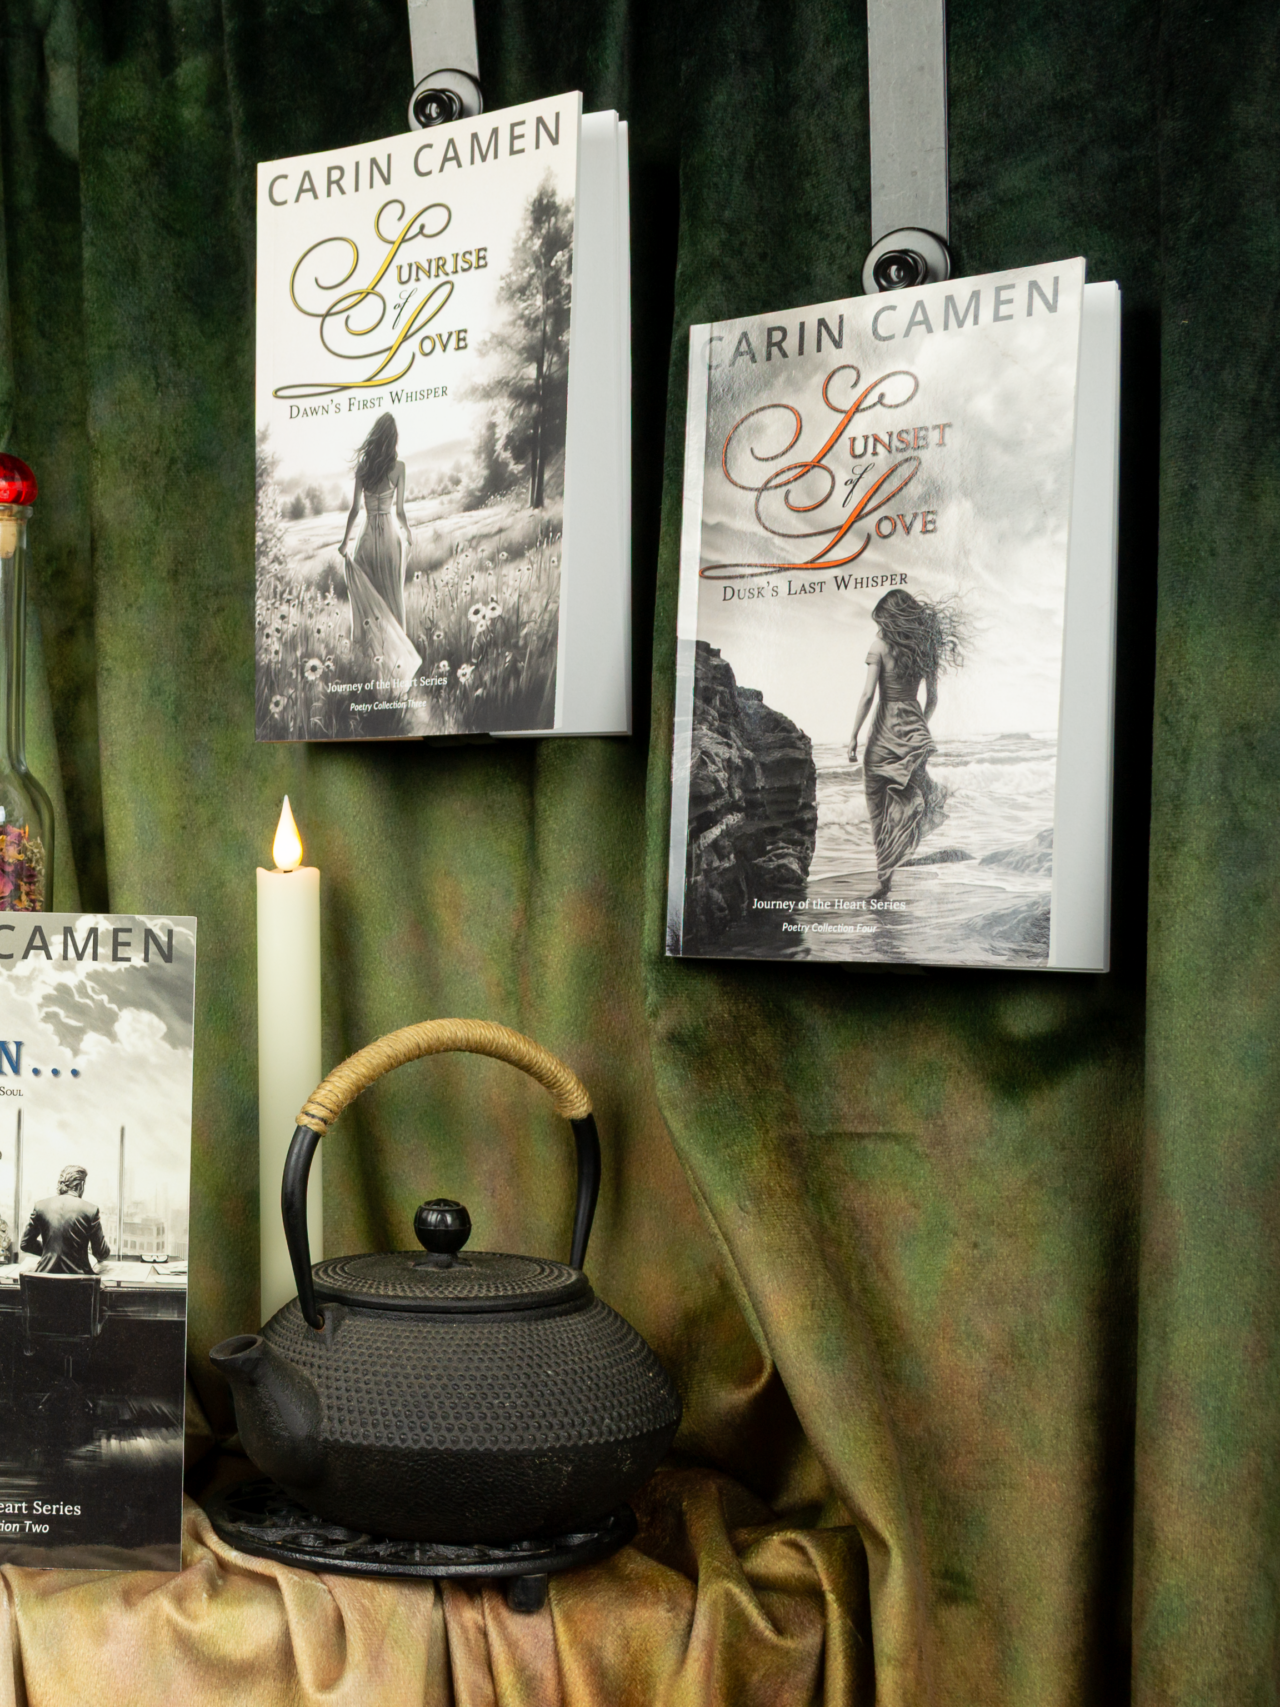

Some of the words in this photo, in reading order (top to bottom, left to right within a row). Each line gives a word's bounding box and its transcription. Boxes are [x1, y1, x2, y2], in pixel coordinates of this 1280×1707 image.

[268, 153, 392, 207] CARIN
[413, 111, 561, 177] CAMEN
[392, 288, 418, 330] of
[699, 313, 845, 372] CARIN
[871, 275, 1061, 344] CAMEN
[347, 395, 384, 412] FIRST
[389, 385, 448, 405] WHISPER
[844, 462, 875, 508] of
[787, 578, 827, 597] LAST
[833, 571, 909, 592] WHISPER
[327, 680, 363, 693] Journey
[364, 680, 376, 690] of
[376, 679, 390, 690] the
[420, 676, 448, 687] Series
[350, 702, 373, 712] Poetry
[374, 700, 406, 711] Collection
[752, 898, 796, 913] Journey
[798, 898, 810, 910] of
[812, 898, 831, 910] the
[834, 898, 867, 911] Heart
[869, 898, 906, 911] Series
[782, 922, 810, 934] Poetry
[811, 922, 854, 933] Collection
[856, 923, 877, 934] Four
[32, 1501, 82, 1516] Series
[23, 1520, 50, 1534] Two
